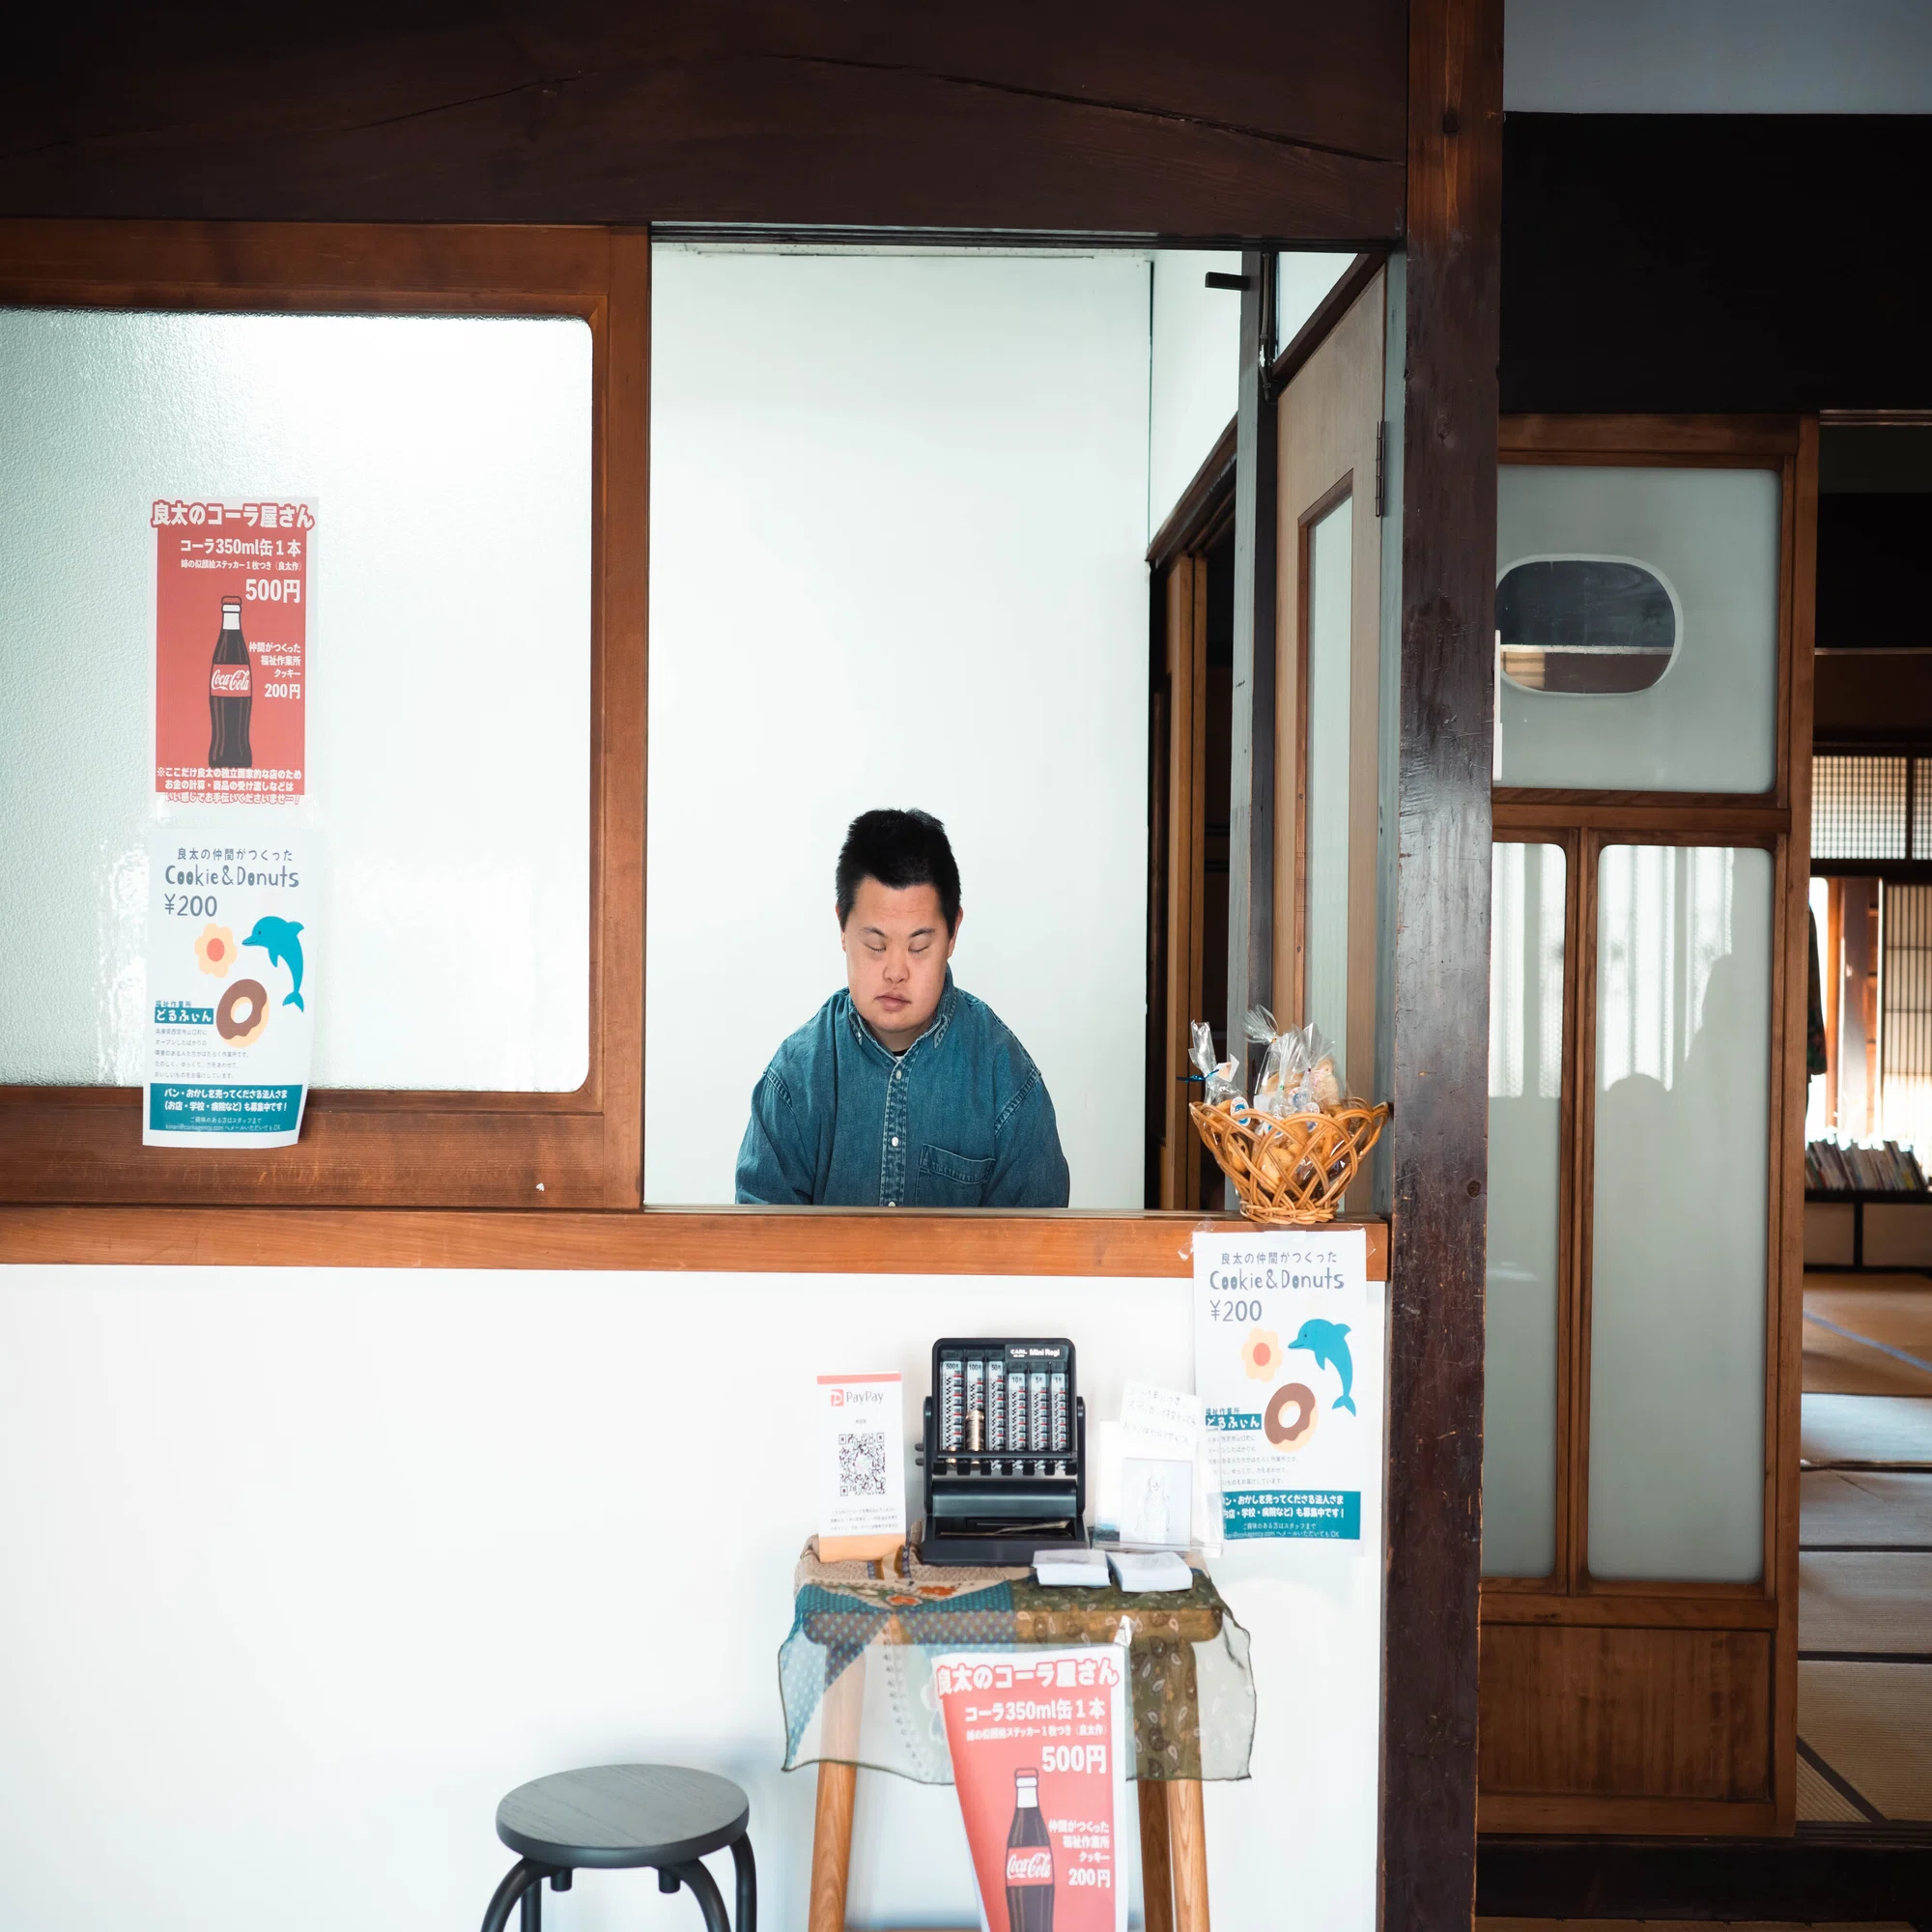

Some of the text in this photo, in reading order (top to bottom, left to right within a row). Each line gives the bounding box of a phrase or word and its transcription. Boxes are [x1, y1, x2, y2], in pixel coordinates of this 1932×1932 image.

[152, 501, 314, 529] 良太のコーラ屋さん
[244, 579, 300, 603] 500円
[248, 641, 301, 653] 仲間がつくった
[261, 655, 301, 667] 福祉作業所
[273, 668, 301, 678] クッキー
[264, 683, 300, 699] 200円
[177, 847, 293, 862] 良太の仲間がつくった
[165, 865, 299, 888] Cookie&Donuts
[164, 893, 217, 917] ¥200
[1221, 1251, 1337, 1264] 良太の仲間がつくった
[1209, 1267, 1345, 1291] Cookie&Donuts
[1209, 1299, 1263, 1321] ¥200
[846, 1391, 884, 1405] PayPay
[1223, 1494, 1344, 1506] ン・おかしを売ってくださる法人さま
[937, 1658, 1119, 1696] 良太のコーラ屋さん
[1041, 1745, 1106, 1774] 500円
[1048, 1820, 1109, 1833] 仲間がつくった
[1079, 1851, 1110, 1863] クッキー
[1068, 1868, 1111, 1889] 200円
